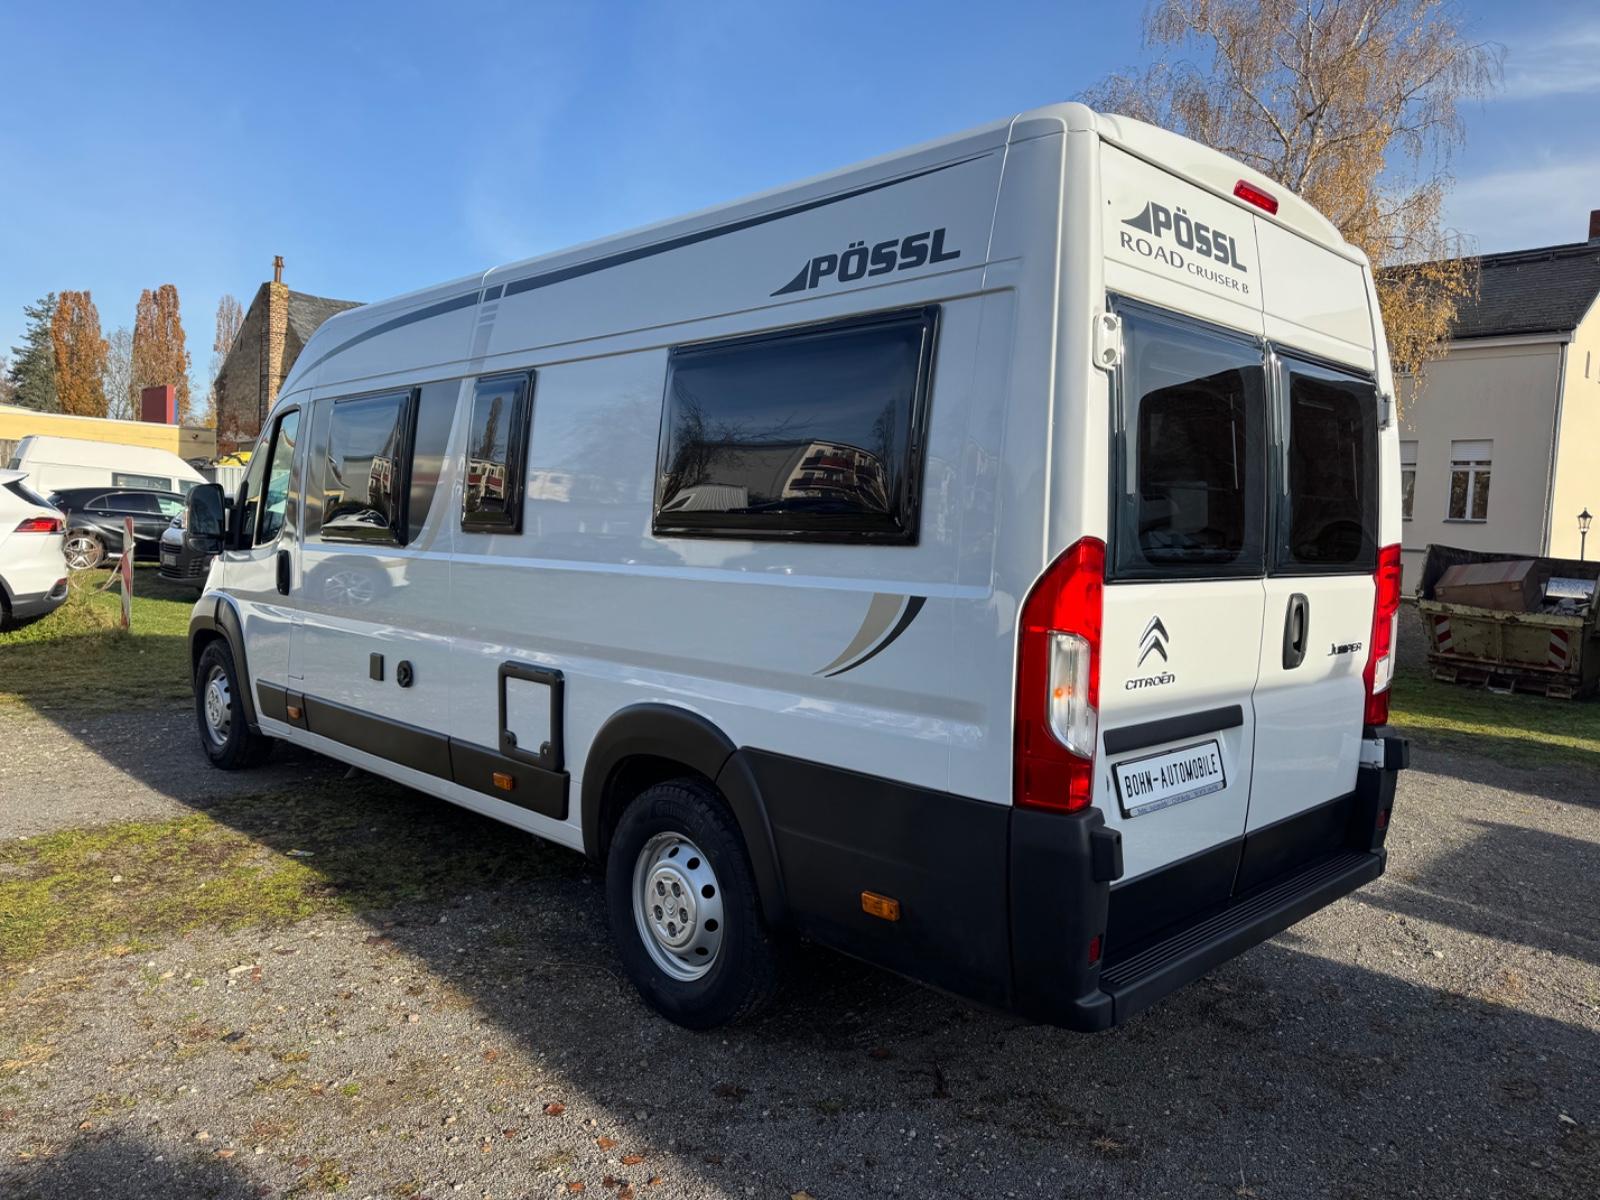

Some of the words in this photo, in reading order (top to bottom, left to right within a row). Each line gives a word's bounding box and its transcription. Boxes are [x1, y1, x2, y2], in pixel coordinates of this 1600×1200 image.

[808, 227, 962, 289] PÖSSL
[1119, 230, 1185, 270] ROAD
[1186, 261, 1241, 292] CRUISER
[1241, 282, 1250, 294] B
[1150, 201, 1248, 273] PÖSSL
[1124, 753, 1219, 799] BOHN-AUTOMOBILE
